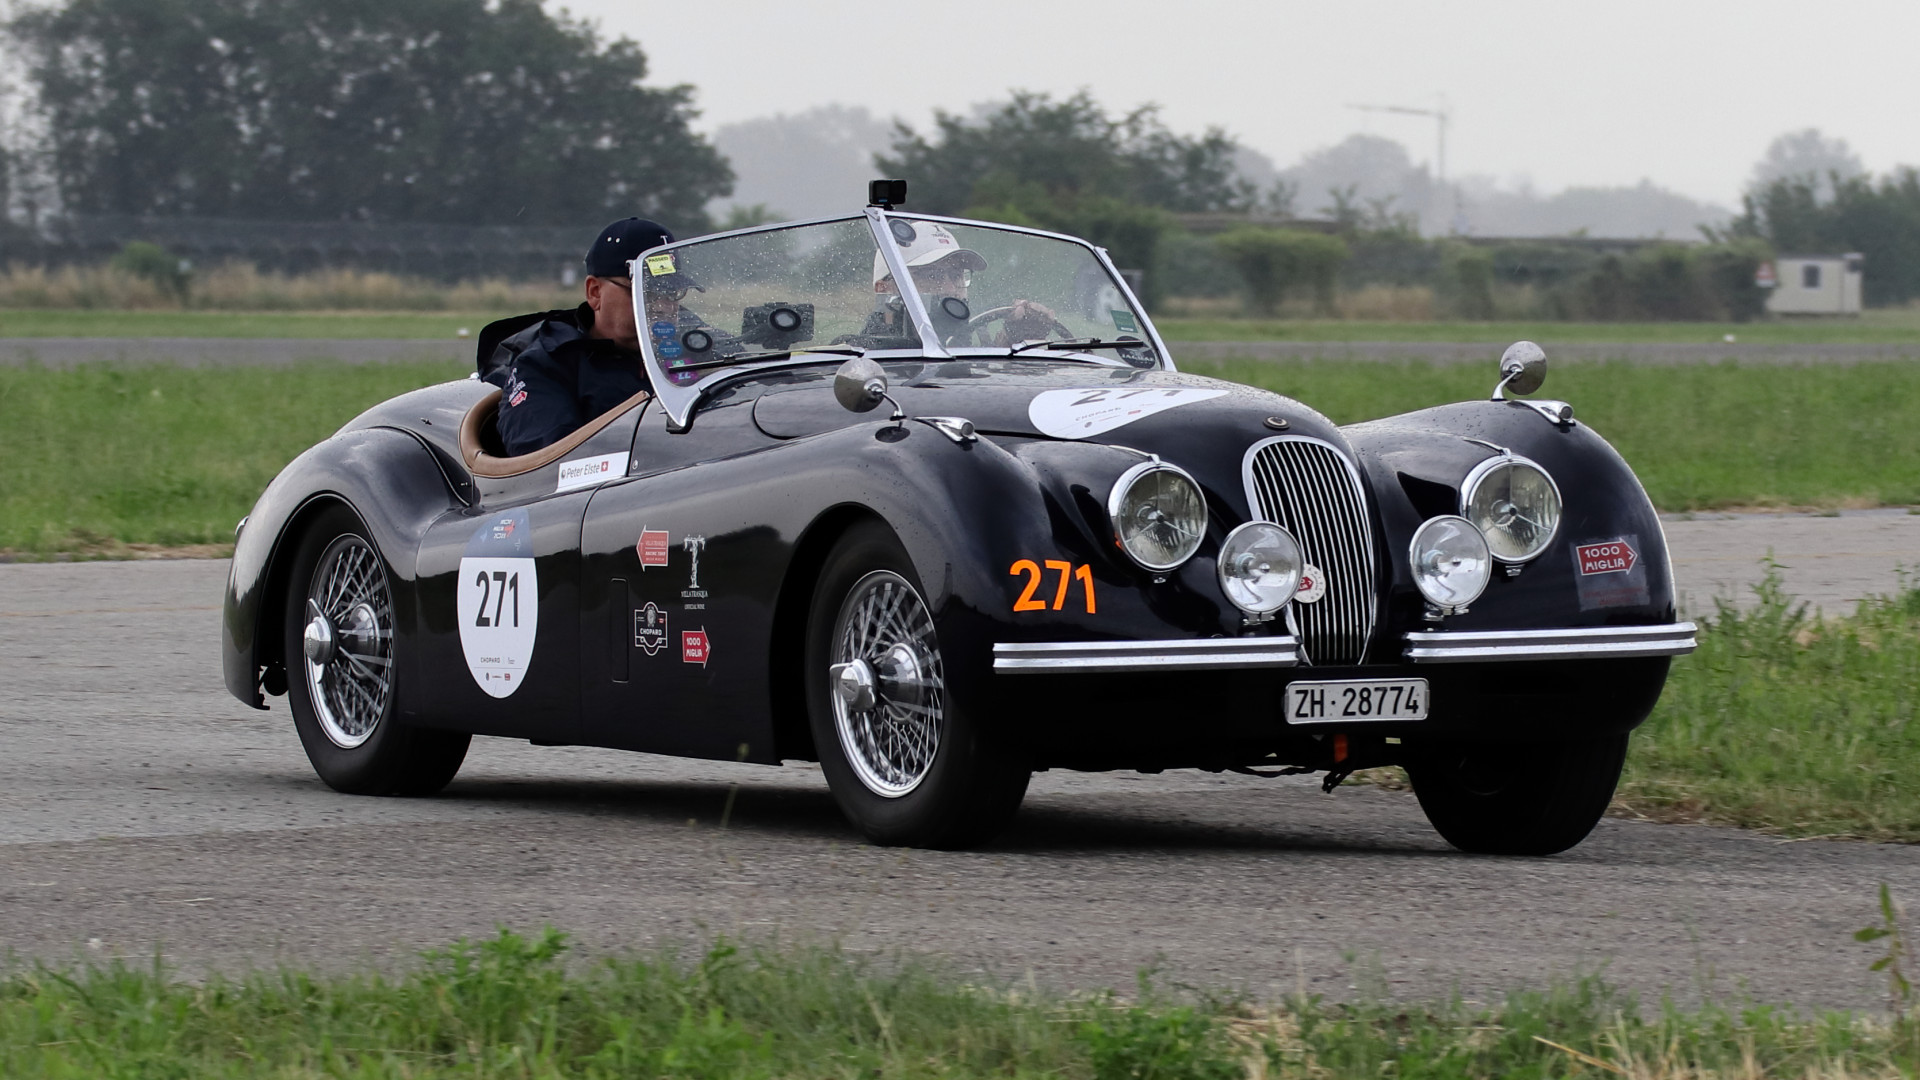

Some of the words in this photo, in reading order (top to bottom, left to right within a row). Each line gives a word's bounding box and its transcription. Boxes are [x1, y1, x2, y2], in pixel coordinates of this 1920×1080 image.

[566, 467, 583, 478] Peter
[584, 463, 600, 475] Elste
[1585, 546, 1620, 558] 1000
[1585, 558, 1626, 571] MIGLIA
[1009, 559, 1097, 615] 271
[475, 571, 518, 628] 271
[640, 627, 662, 636] CHOPARD
[686, 637, 701, 646] 1000
[685, 648, 703, 657] MIGLIA
